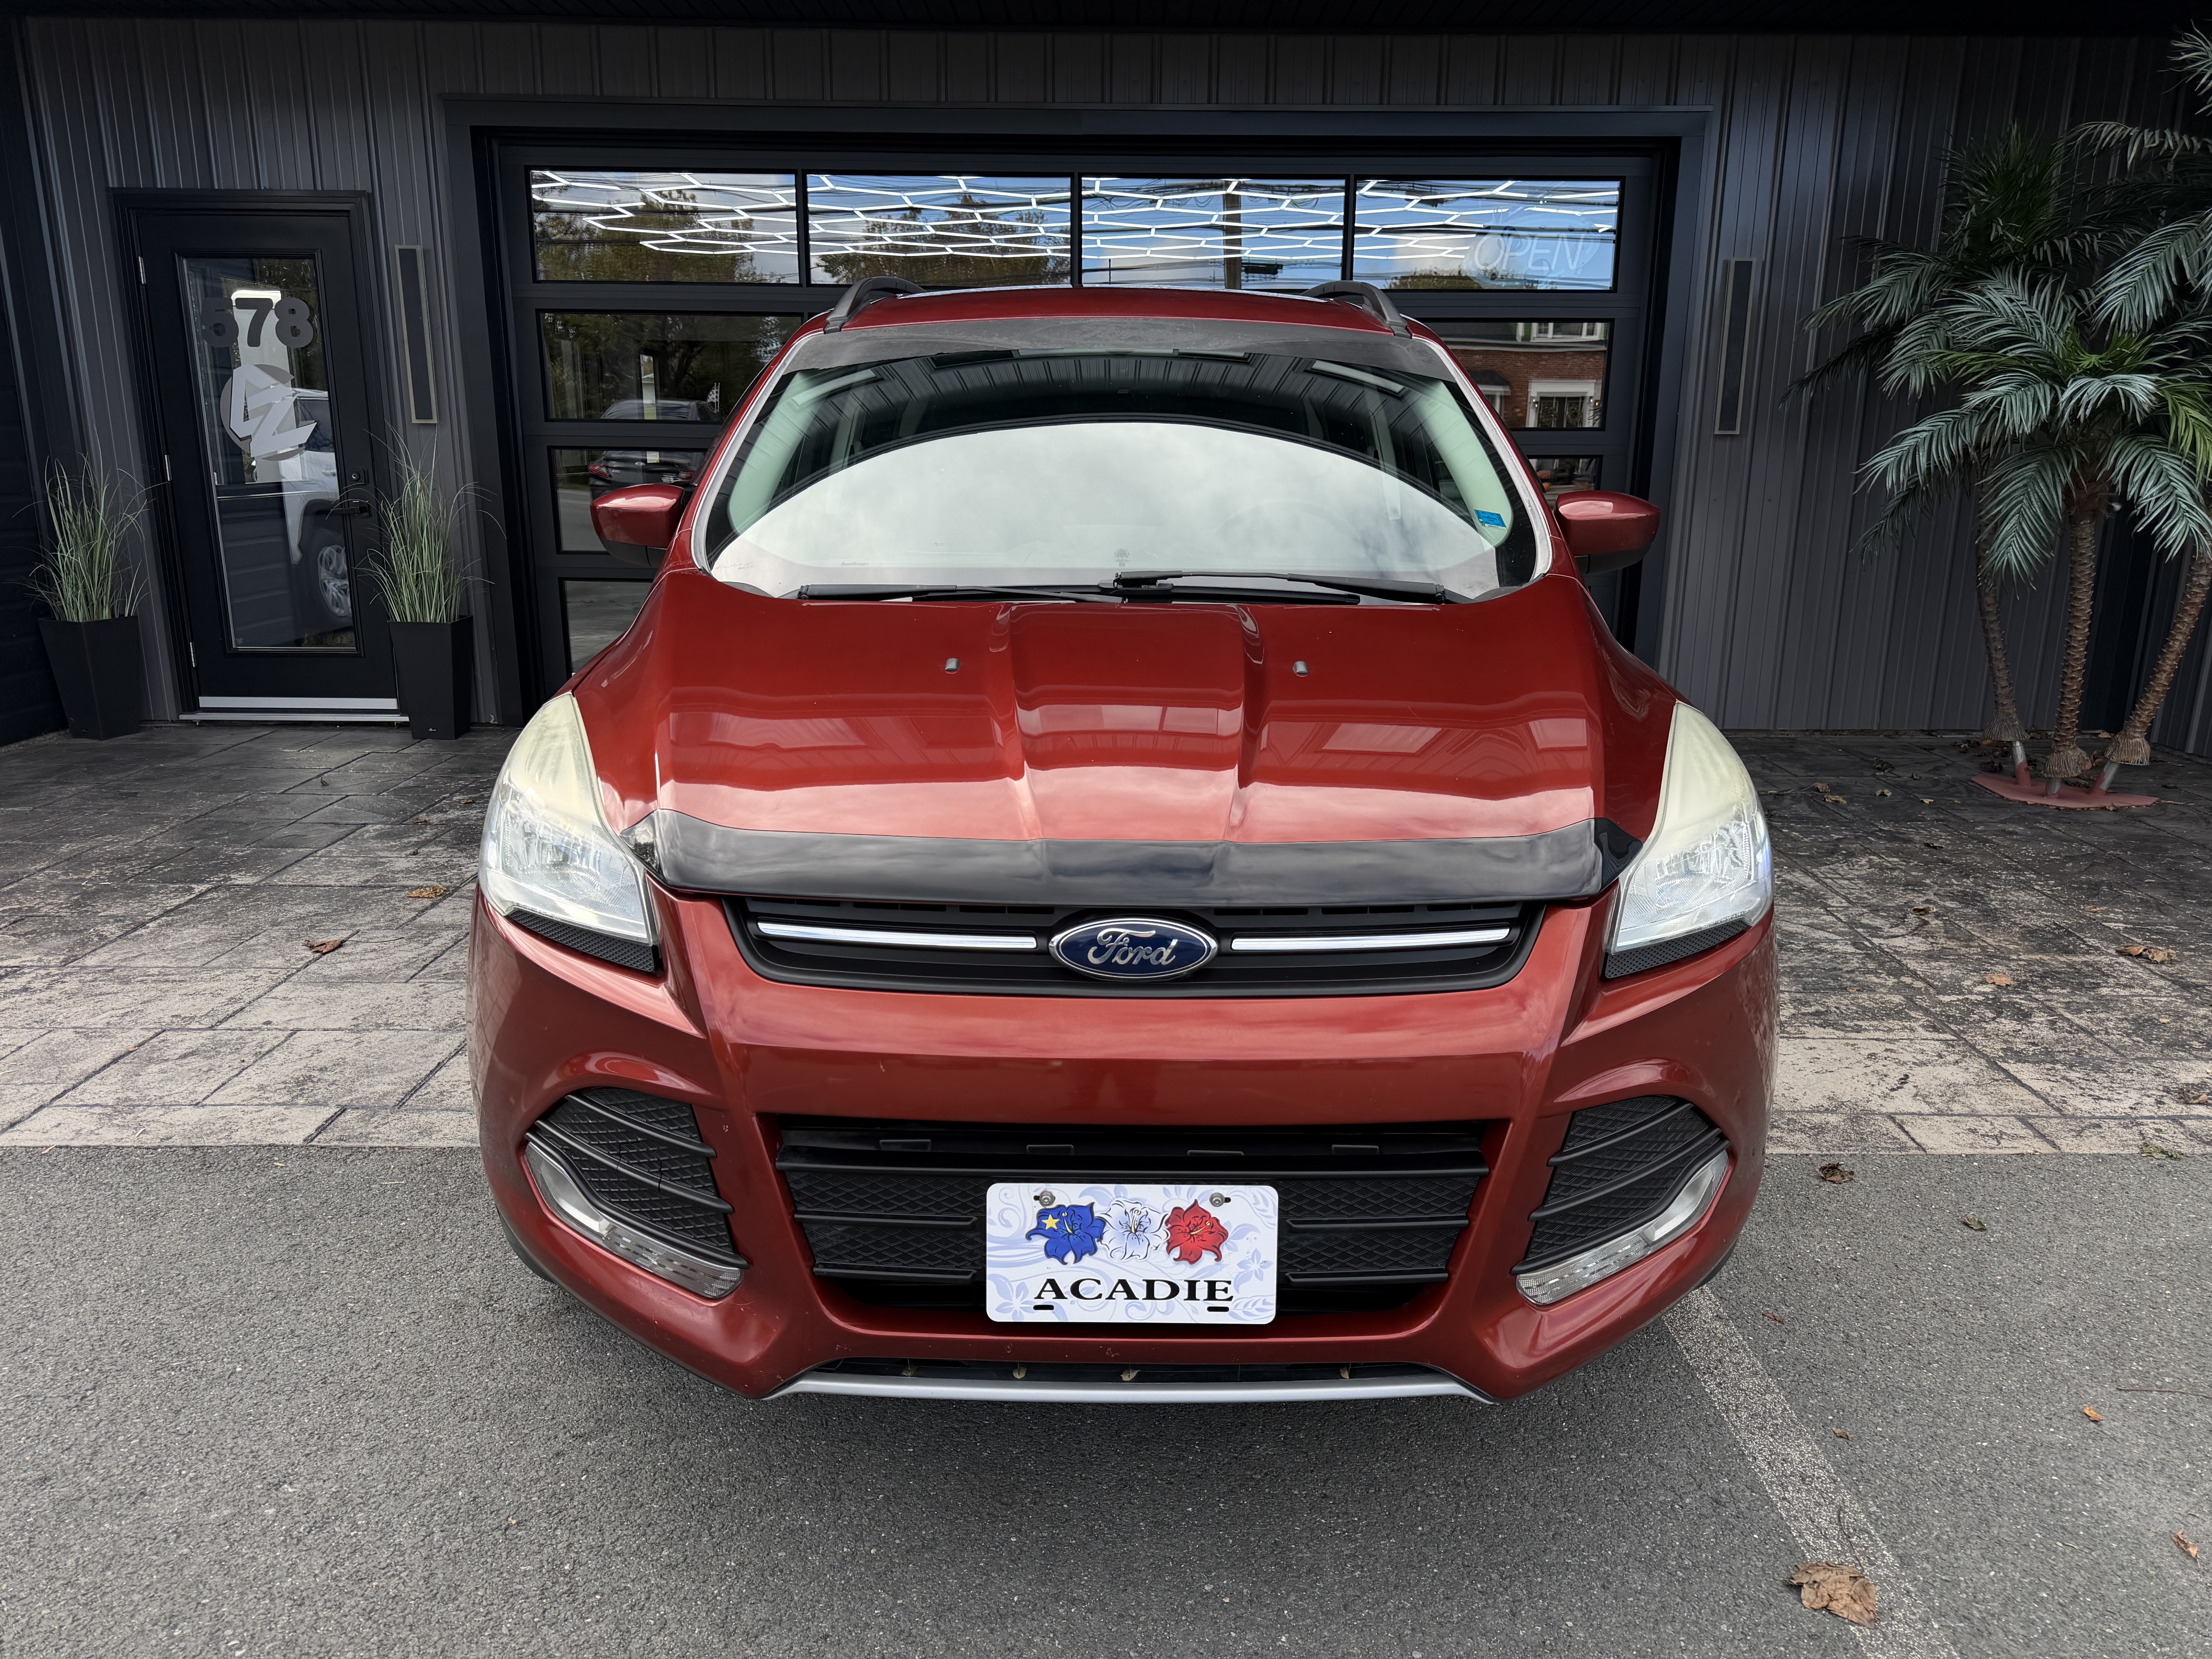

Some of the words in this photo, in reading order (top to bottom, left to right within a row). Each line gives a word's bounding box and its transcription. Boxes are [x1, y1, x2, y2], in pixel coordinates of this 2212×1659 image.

[1474, 233, 1584, 270] OPEN
[201, 297, 313, 349] 578
[1087, 928, 1178, 965] Ford
[1034, 1278, 1234, 1302] ACADIE
